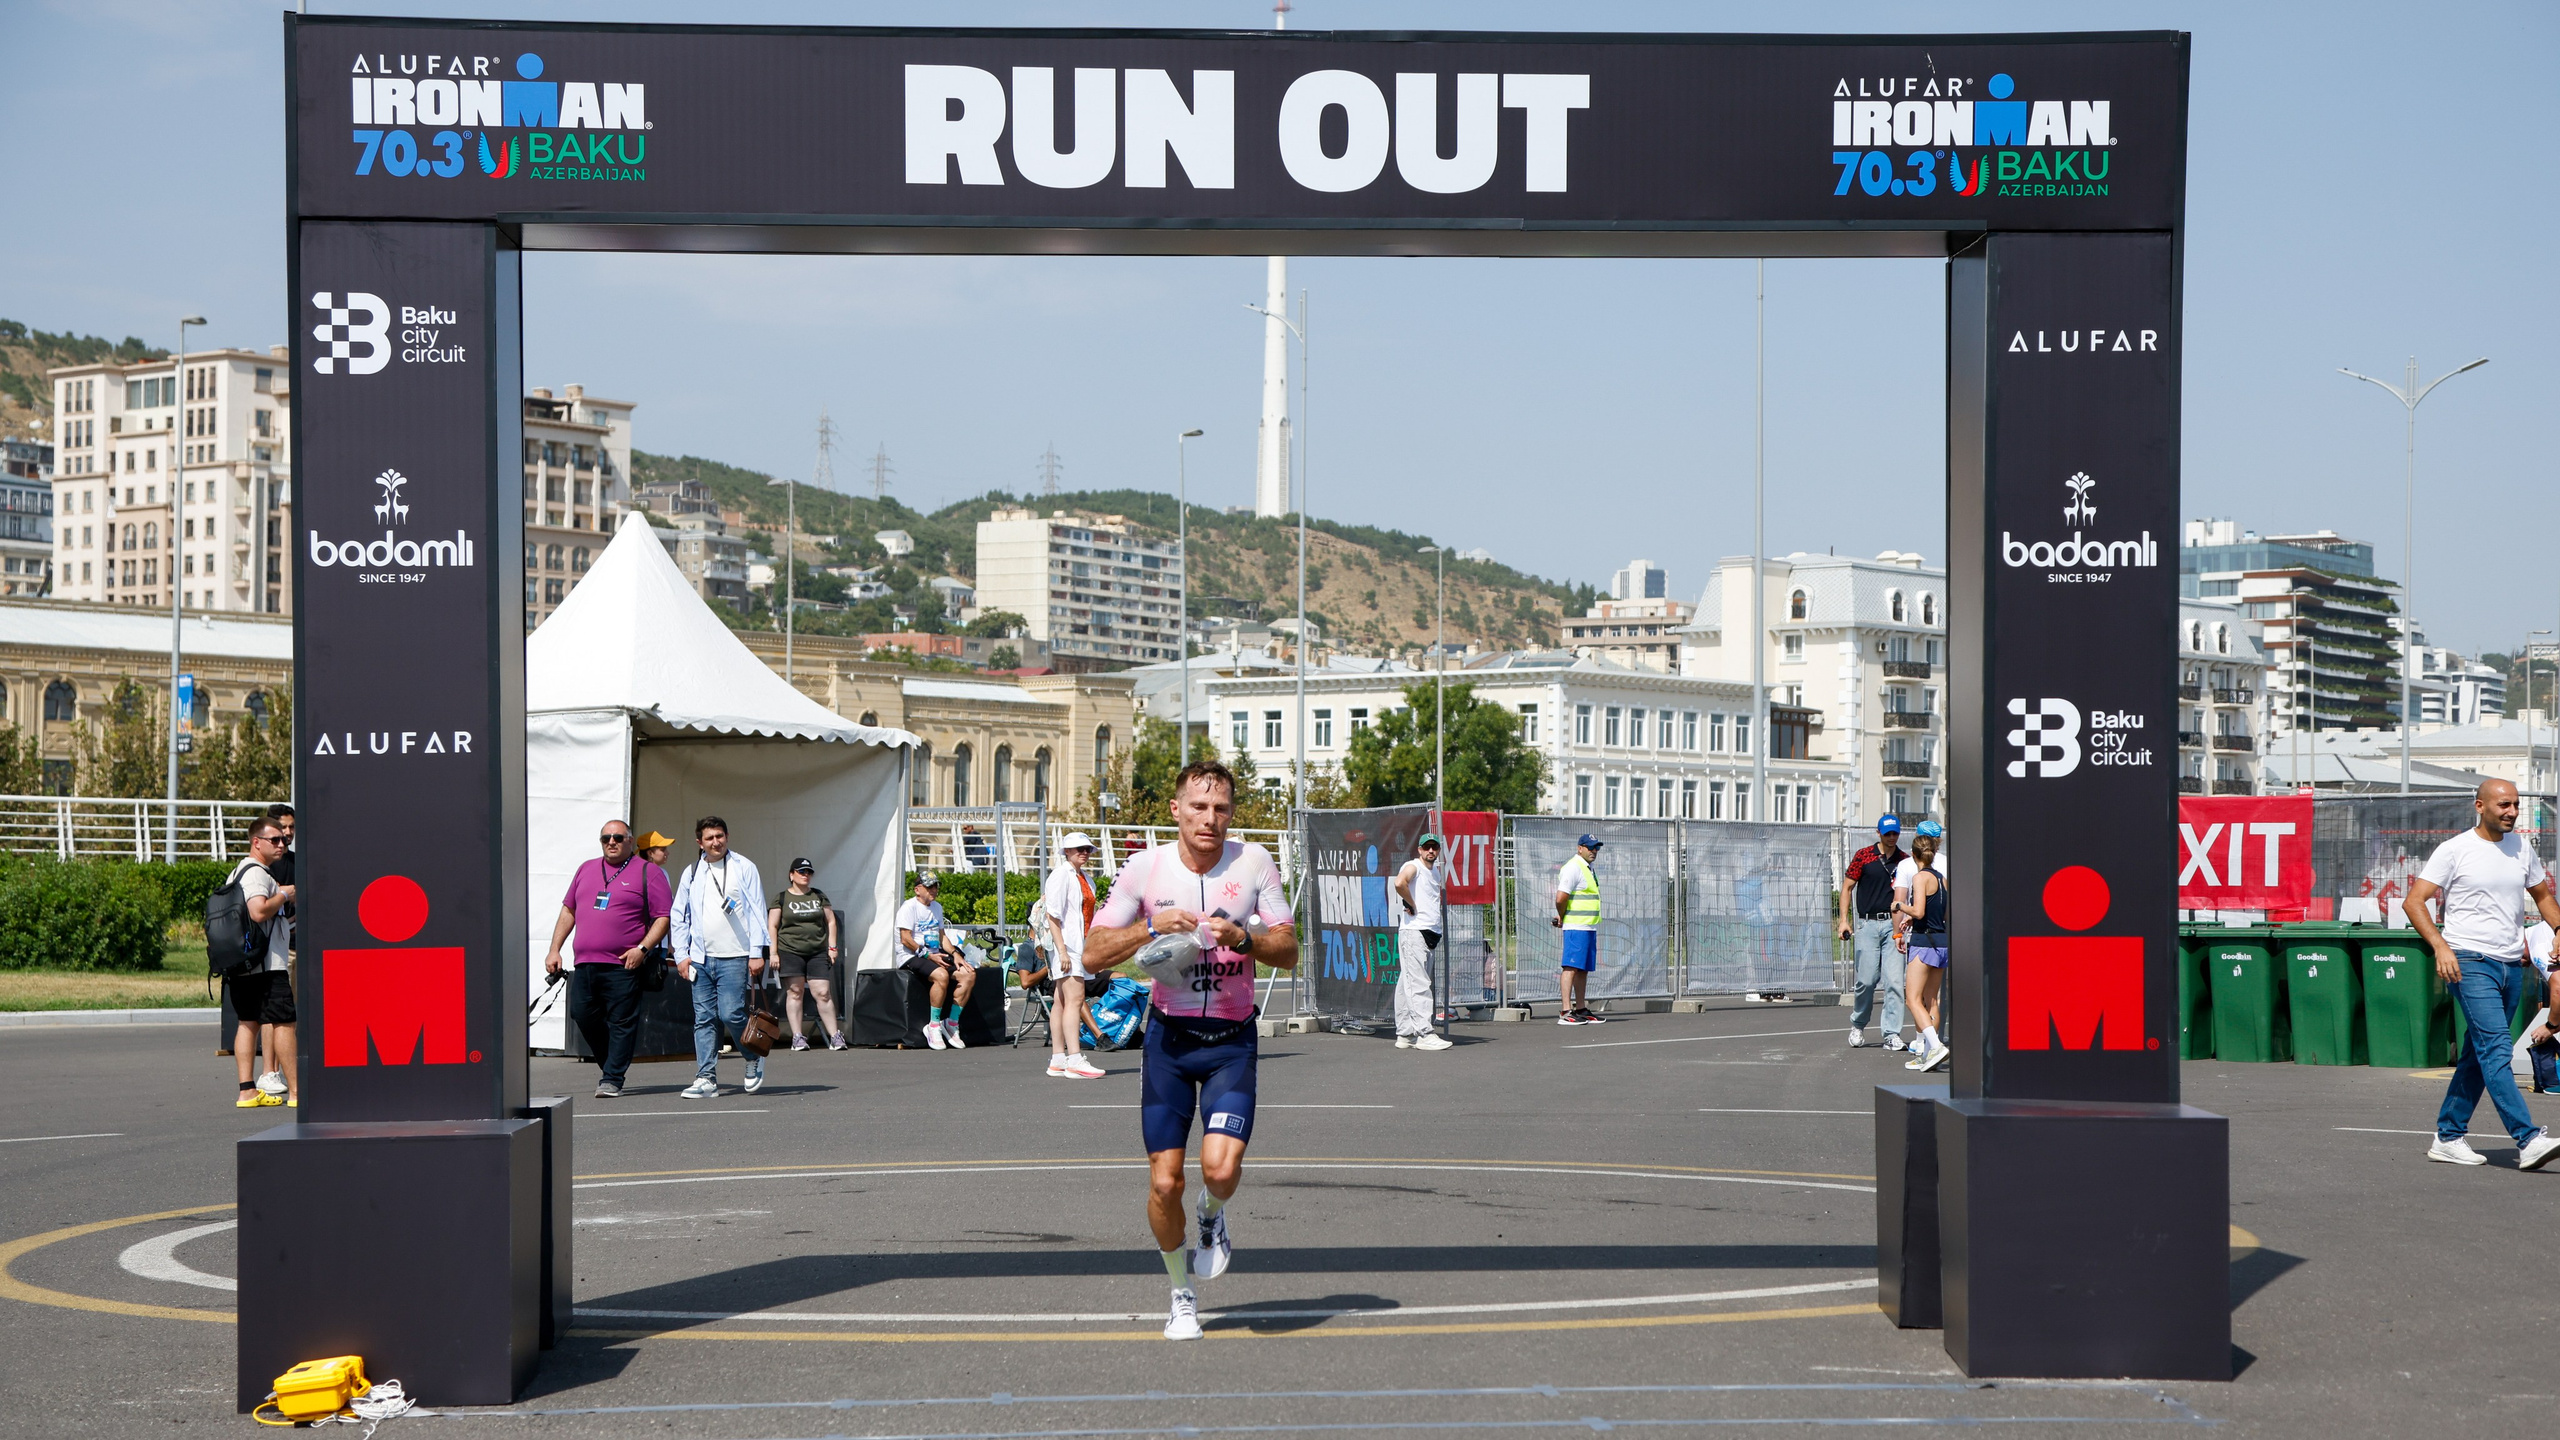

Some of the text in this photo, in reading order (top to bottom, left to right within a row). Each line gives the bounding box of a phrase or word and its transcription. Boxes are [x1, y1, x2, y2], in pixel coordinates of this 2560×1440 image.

[905, 64, 1590, 193] RUN OUT
[529, 133, 645, 164] BAKU
[530, 166, 645, 181] AZERBAIJAN
[1998, 151, 2109, 180] BAKU
[1998, 184, 2109, 197] AZERBAIJAN
[402, 306, 456, 324] Baku
[402, 326, 439, 347] city
[2008, 330, 2158, 352] ALUFAR
[402, 345, 465, 363] circuit
[359, 574, 426, 583] SINCE 1947
[2048, 574, 2112, 583] SINCE 1947
[2091, 710, 2143, 728] Baku
[314, 731, 472, 755] ALUFAR
[2091, 730, 2127, 751] city
[2091, 748, 2152, 766] circuit
[1443, 835, 1490, 886] XIT
[2179, 822, 2296, 887] XIT
[788, 900, 820, 910] ONE
[1318, 874, 1400, 927] IRONMA
[1191, 979, 1222, 992] CRC
